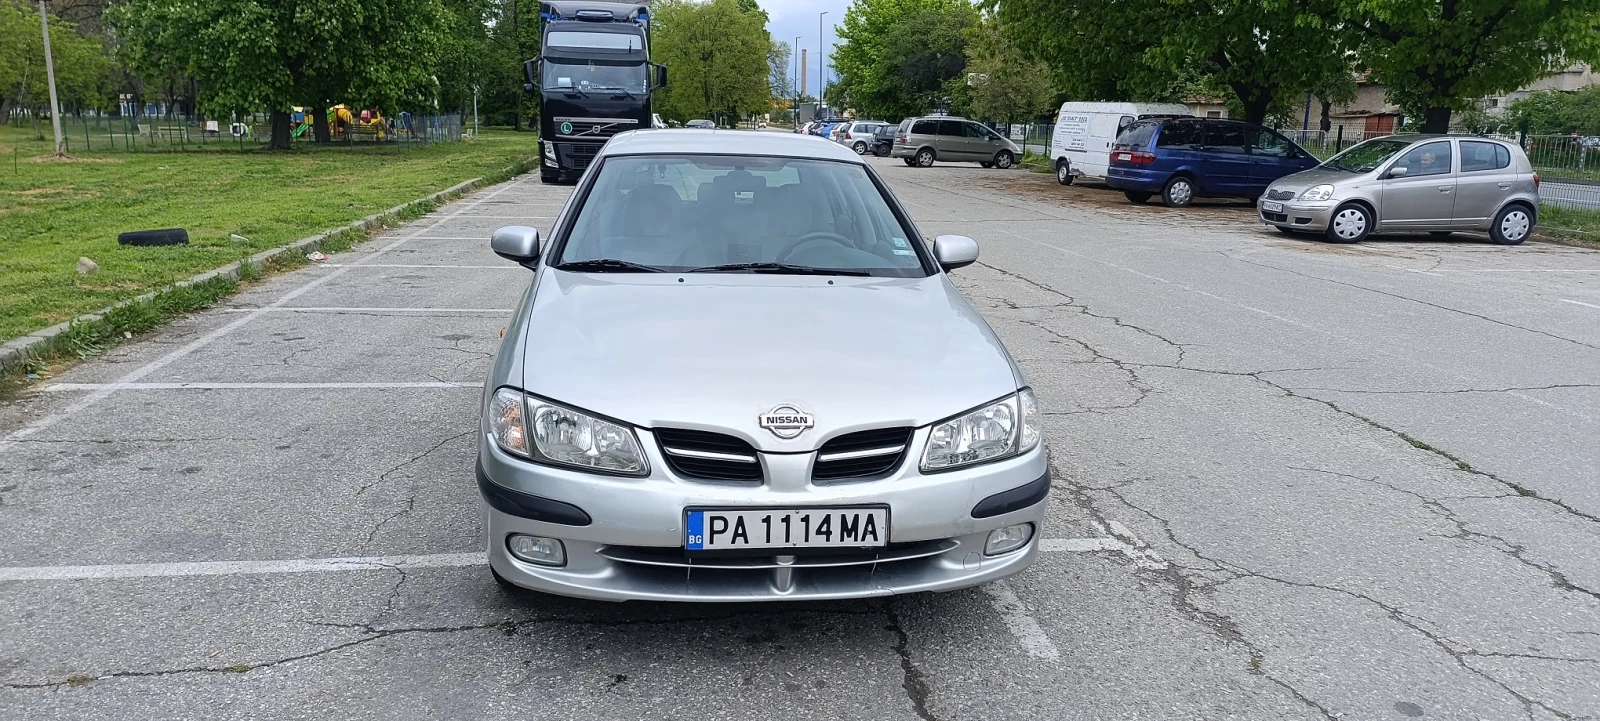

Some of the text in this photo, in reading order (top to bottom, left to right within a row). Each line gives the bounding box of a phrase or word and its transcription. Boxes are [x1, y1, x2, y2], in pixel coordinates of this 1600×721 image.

[766, 416, 808, 424] NISSAN
[709, 515, 749, 545] PA
[688, 535, 702, 544] BG
